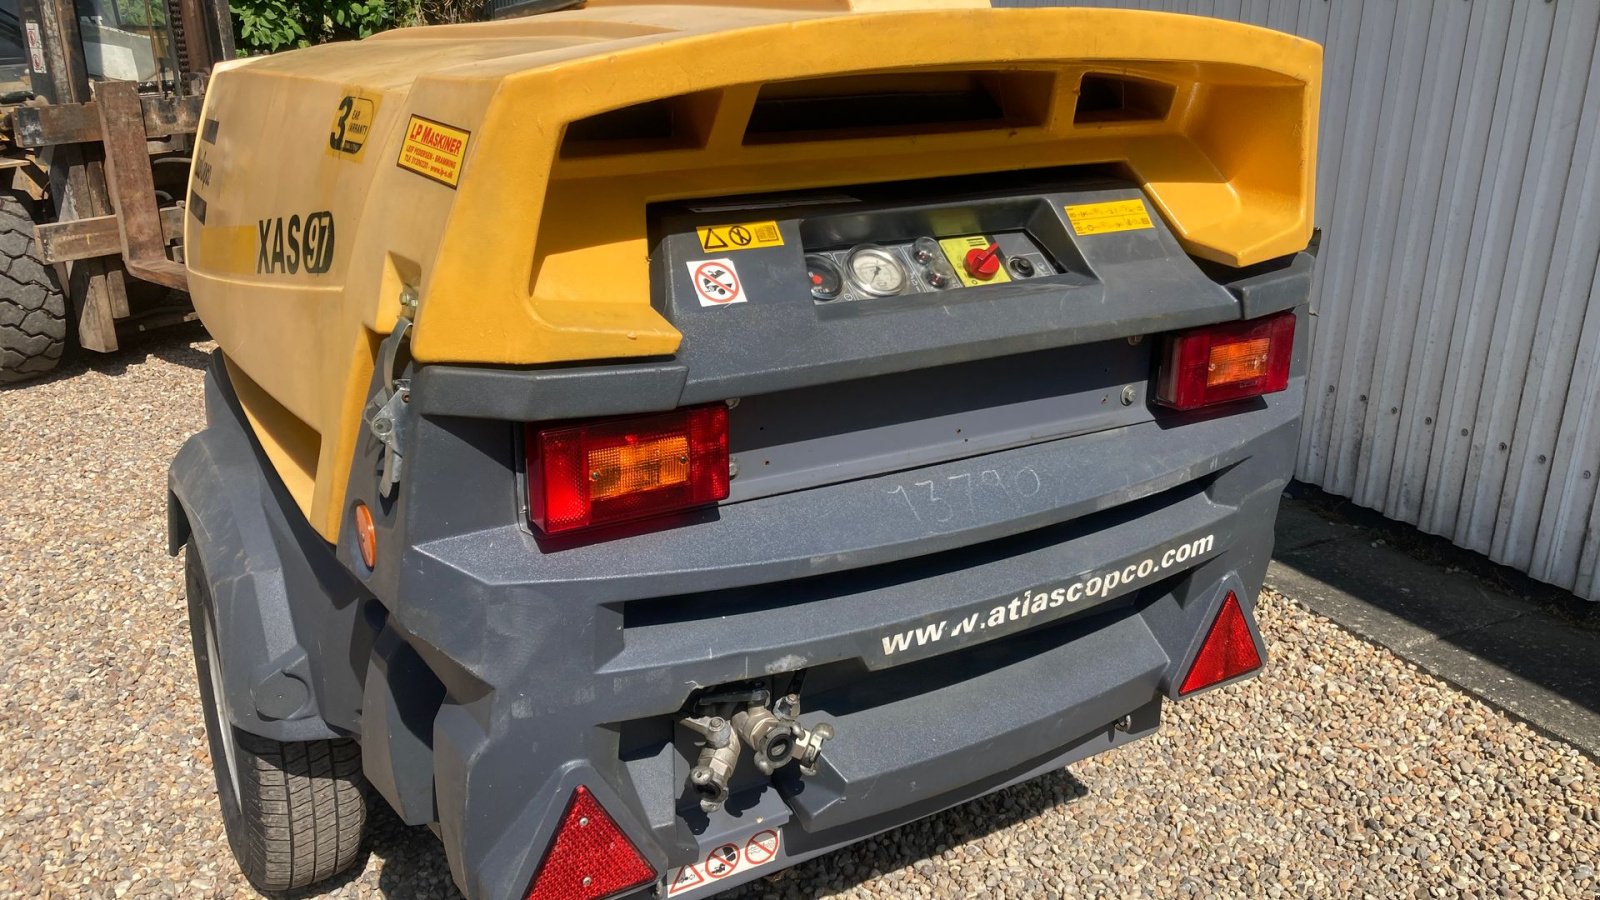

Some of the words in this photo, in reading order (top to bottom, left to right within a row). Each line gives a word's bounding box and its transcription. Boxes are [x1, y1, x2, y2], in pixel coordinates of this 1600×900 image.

[330, 96, 353, 151] 3
[348, 122, 368, 135] ARRANTY
[410, 122, 423, 140] LP
[421, 126, 463, 155] MASKINER
[257, 214, 300, 275] XAS
[305, 215, 331, 270] 97
[887, 466, 1041, 523] 13790
